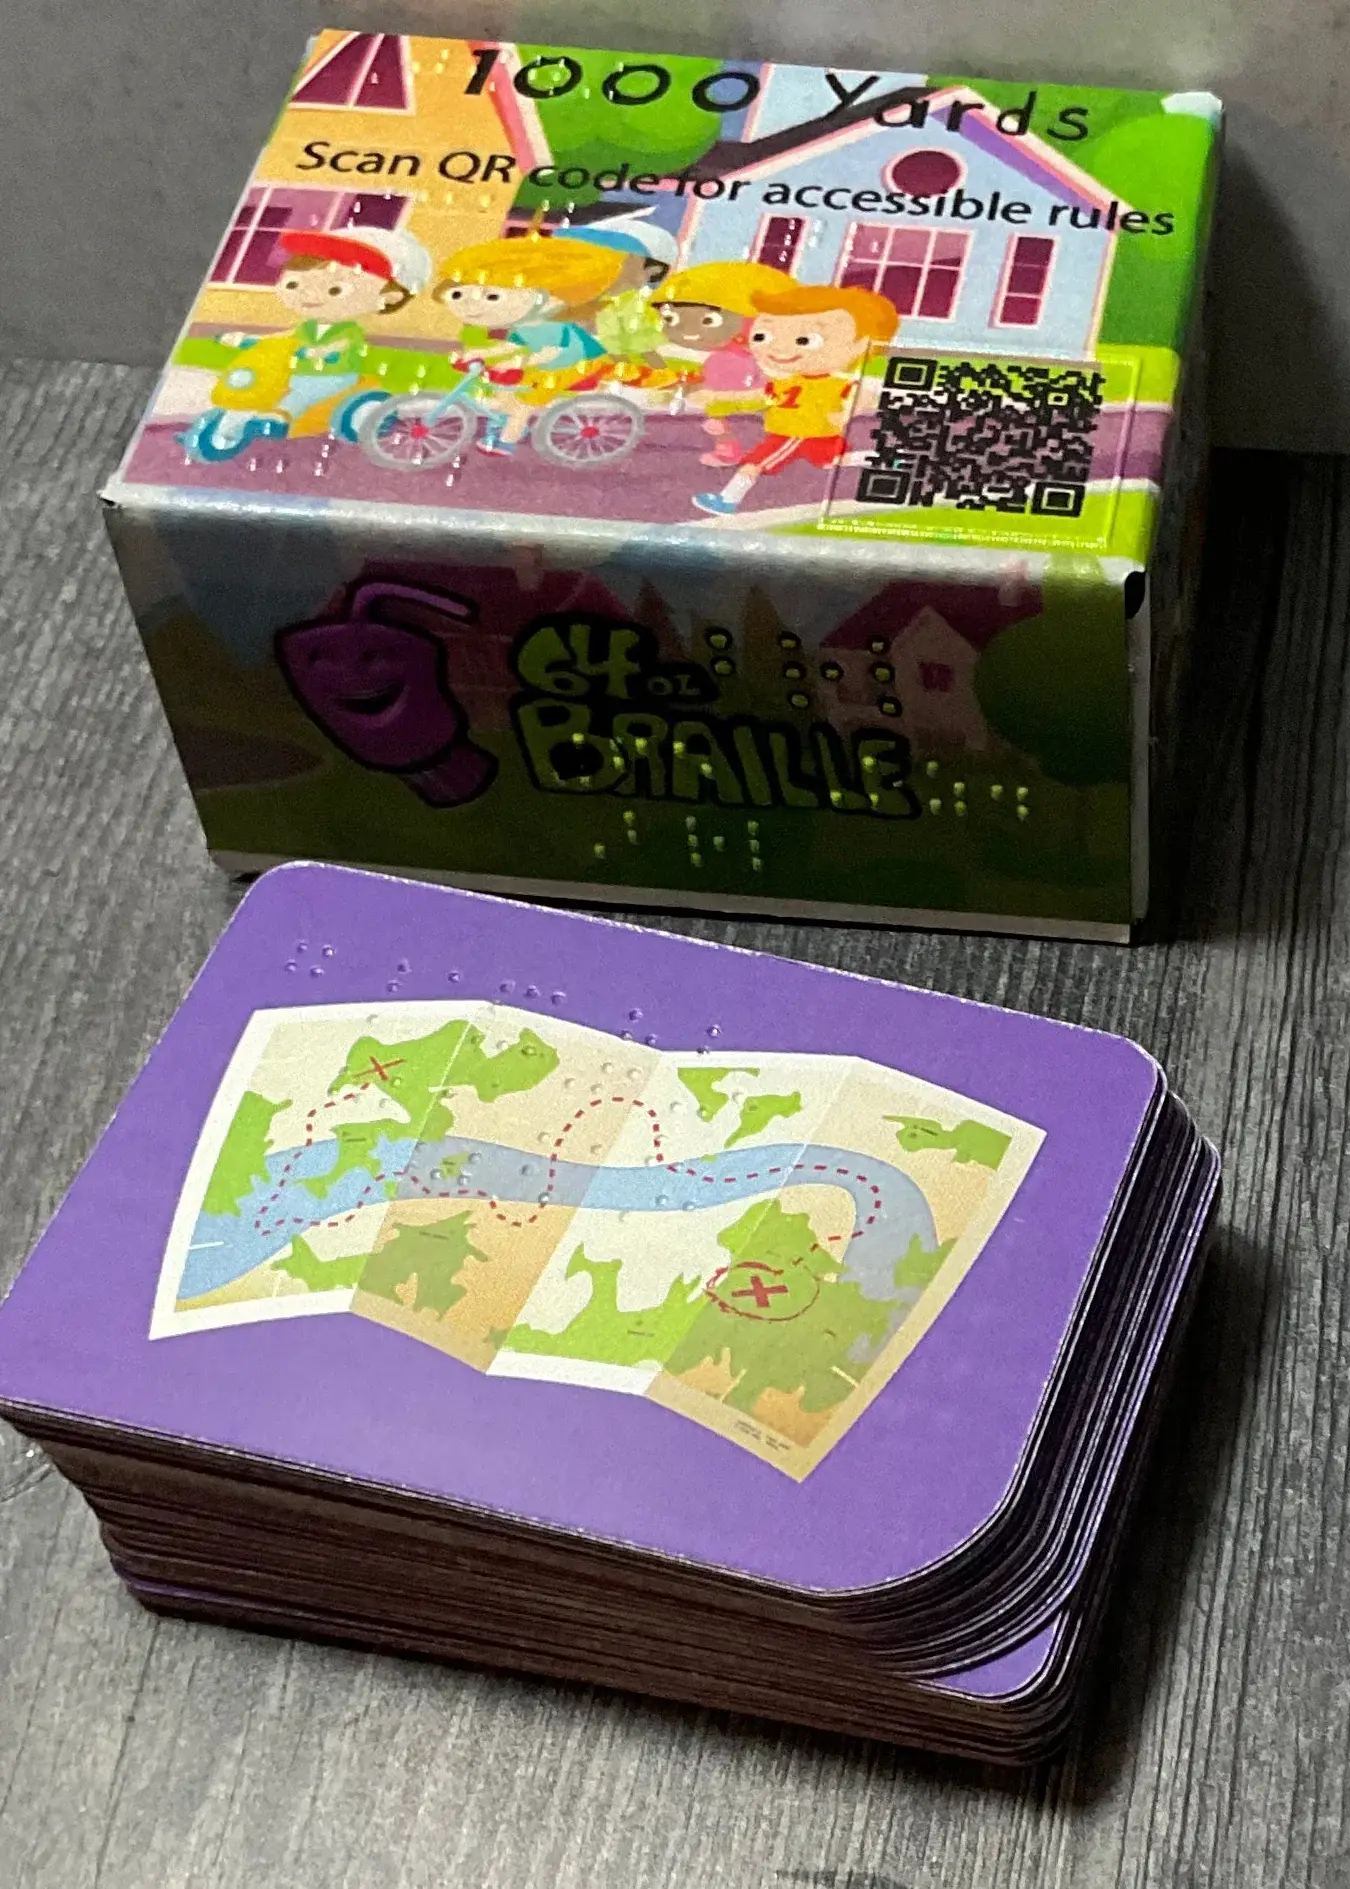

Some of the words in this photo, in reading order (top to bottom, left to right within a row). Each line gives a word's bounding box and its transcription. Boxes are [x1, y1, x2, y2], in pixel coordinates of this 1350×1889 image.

[462, 48, 760, 112] 1000
[295, 140, 422, 177] Scan
[437, 150, 516, 184] QR
[526, 162, 660, 195] code
[670, 166, 752, 203] for
[762, 182, 1033, 224] accessible
[1048, 200, 1176, 236] rules
[516, 623, 642, 701] 64
